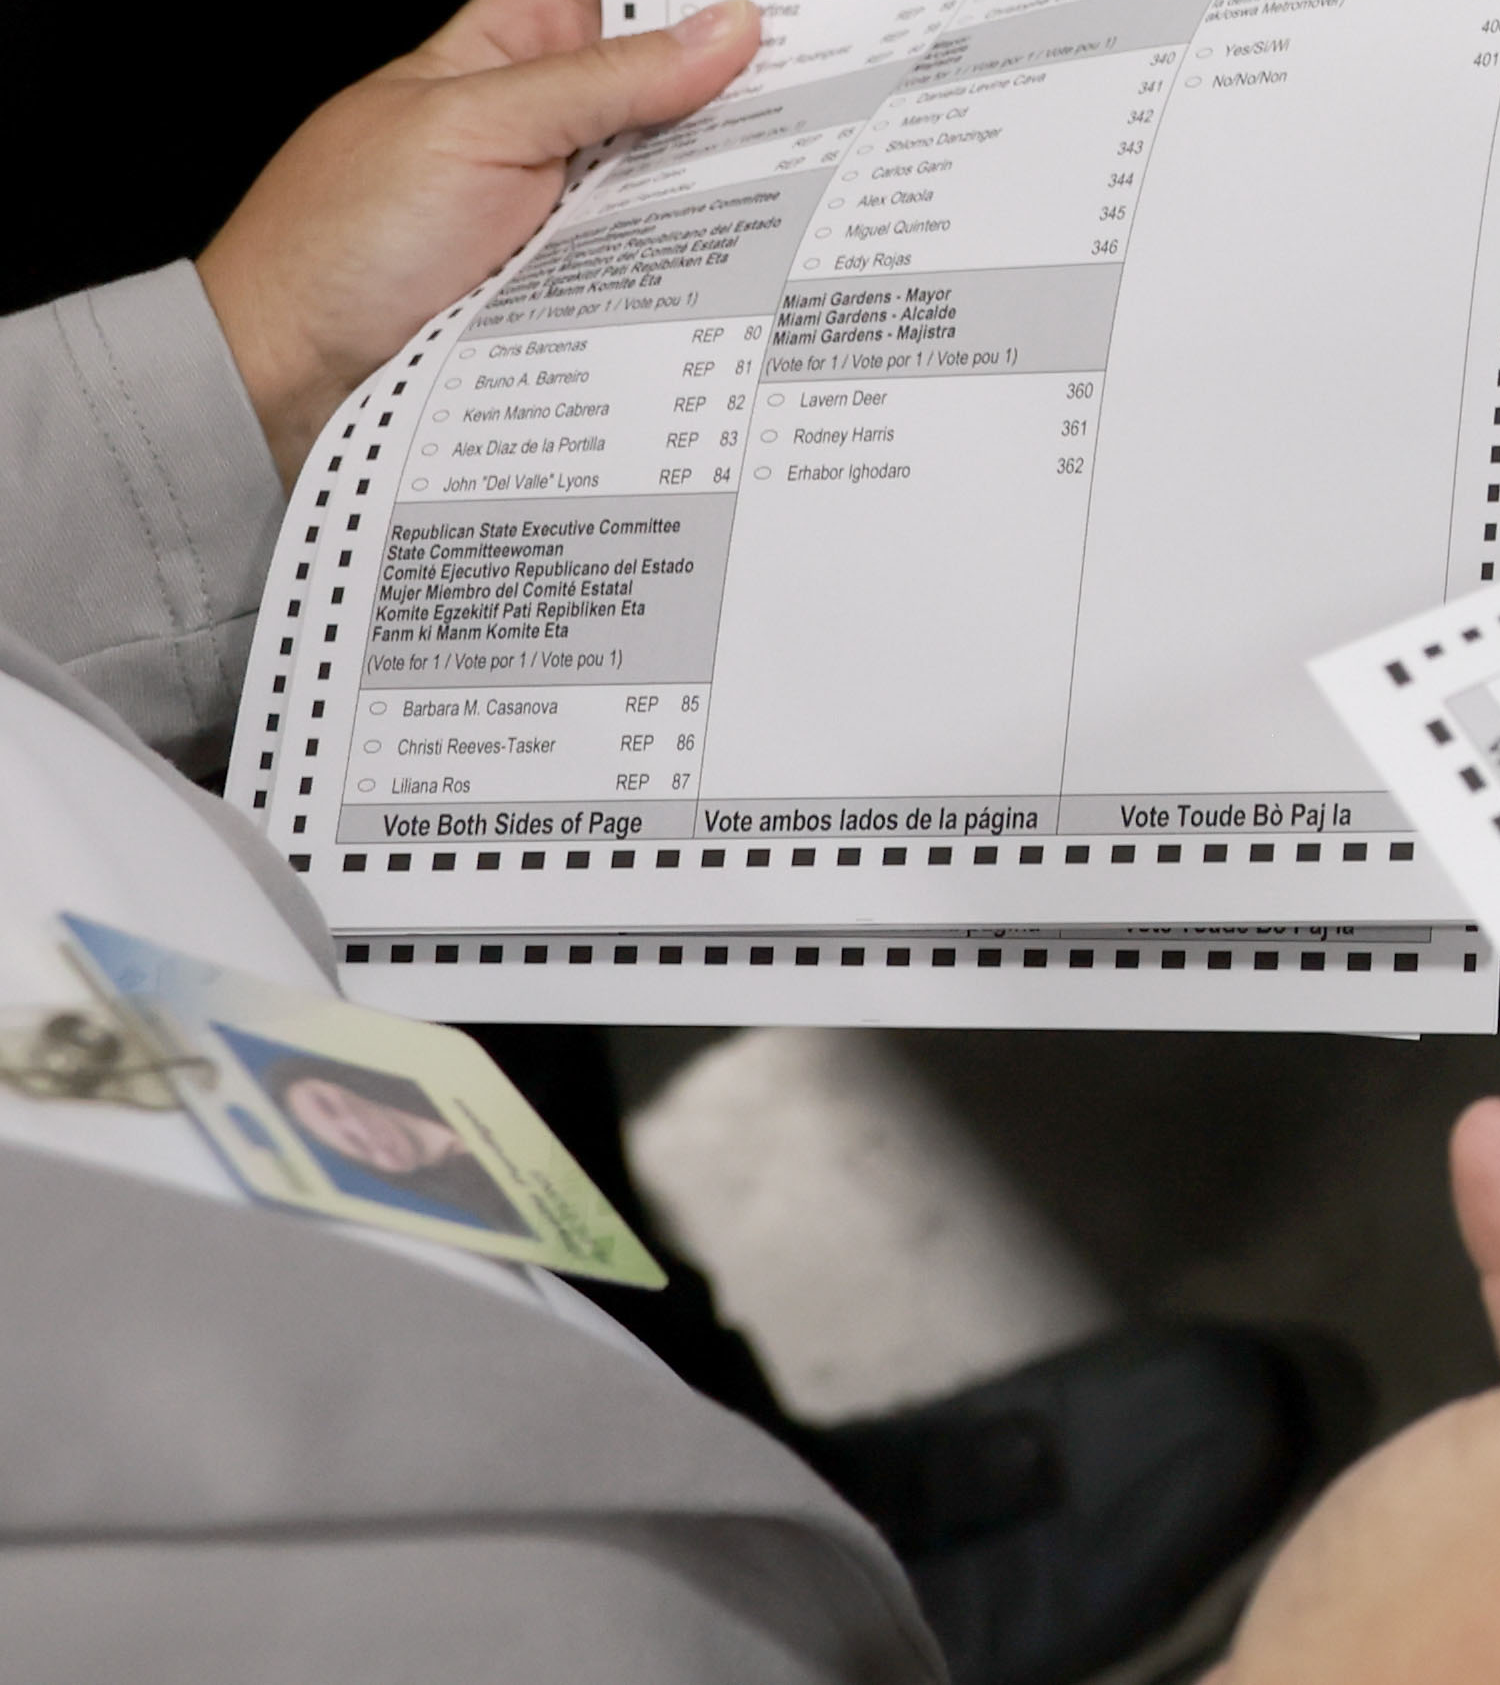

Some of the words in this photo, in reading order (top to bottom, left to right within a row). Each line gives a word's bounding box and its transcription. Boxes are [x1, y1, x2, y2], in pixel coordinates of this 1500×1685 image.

[800, 390, 848, 409] Lavern
[852, 389, 887, 406] Deer
[1066, 381, 1094, 400] 360
[793, 428, 848, 447] Rodney
[852, 426, 895, 443] Harris
[1061, 420, 1088, 437] 361
[442, 476, 477, 493] John
[481, 474, 511, 491] "Del
[515, 472, 554, 490] Valle"
[558, 473, 600, 492] Lyons
[658, 468, 692, 486] REP
[713, 466, 732, 483] 84
[787, 464, 844, 482] Erhabor
[848, 463, 911, 484] Ighodaro
[1056, 457, 1084, 475] 362
[391, 522, 475, 545] Republican
[479, 522, 518, 540] State
[522, 519, 594, 538] Executive
[599, 518, 681, 536] Committee
[387, 544, 425, 562] State
[429, 542, 564, 560] Committeewoman
[383, 562, 437, 582] Comité
[440, 561, 510, 582] Ejecutivo
[515, 560, 609, 580] Republicano
[613, 558, 637, 575] del
[641, 558, 695, 575] Estado
[379, 584, 421, 604] Mujer
[425, 583, 491, 600] Miembro
[495, 582, 518, 599] del
[522, 581, 576, 598] Comité
[580, 580, 633, 597] Estatal
[375, 604, 429, 623] Komite
[433, 603, 500, 624] Egzekitif
[504, 602, 533, 619] Pati
[536, 601, 617, 620] Repibliken
[621, 600, 646, 616] Eta
[372, 625, 415, 642] Fanm
[418, 624, 433, 641] ki
[436, 623, 482, 641] Manm
[486, 622, 540, 639] Komite
[544, 621, 569, 638] Eta
[402, 699, 460, 718] Barbara
[463, 700, 480, 716] M.
[487, 699, 558, 716] Casanova
[625, 696, 659, 714] REP
[681, 696, 700, 713] 85
[398, 738, 442, 756] Christi
[447, 737, 556, 755] Reeves-Tasker
[620, 734, 654, 752] REP
[676, 734, 695, 751] 86
[391, 777, 438, 795] Liliana
[442, 777, 470, 793] Ros
[615, 773, 650, 791] REP
[672, 773, 690, 790] 87
[383, 814, 430, 837] Vote
[437, 813, 487, 837] Both
[494, 812, 554, 835] Sides
[561, 812, 583, 834] of
[588, 811, 642, 840] Page
[704, 809, 752, 832] Vote
[759, 809, 832, 832] ambos
[840, 807, 898, 831] lados
[905, 807, 932, 831] de
[938, 806, 957, 830] la
[964, 806, 1039, 836] página
[1120, 804, 1170, 828] Vote
[1177, 804, 1246, 827] Toude
[1253, 803, 1283, 826] Bò
[1291, 803, 1326, 833] Paj
[1332, 803, 1352, 826] la
